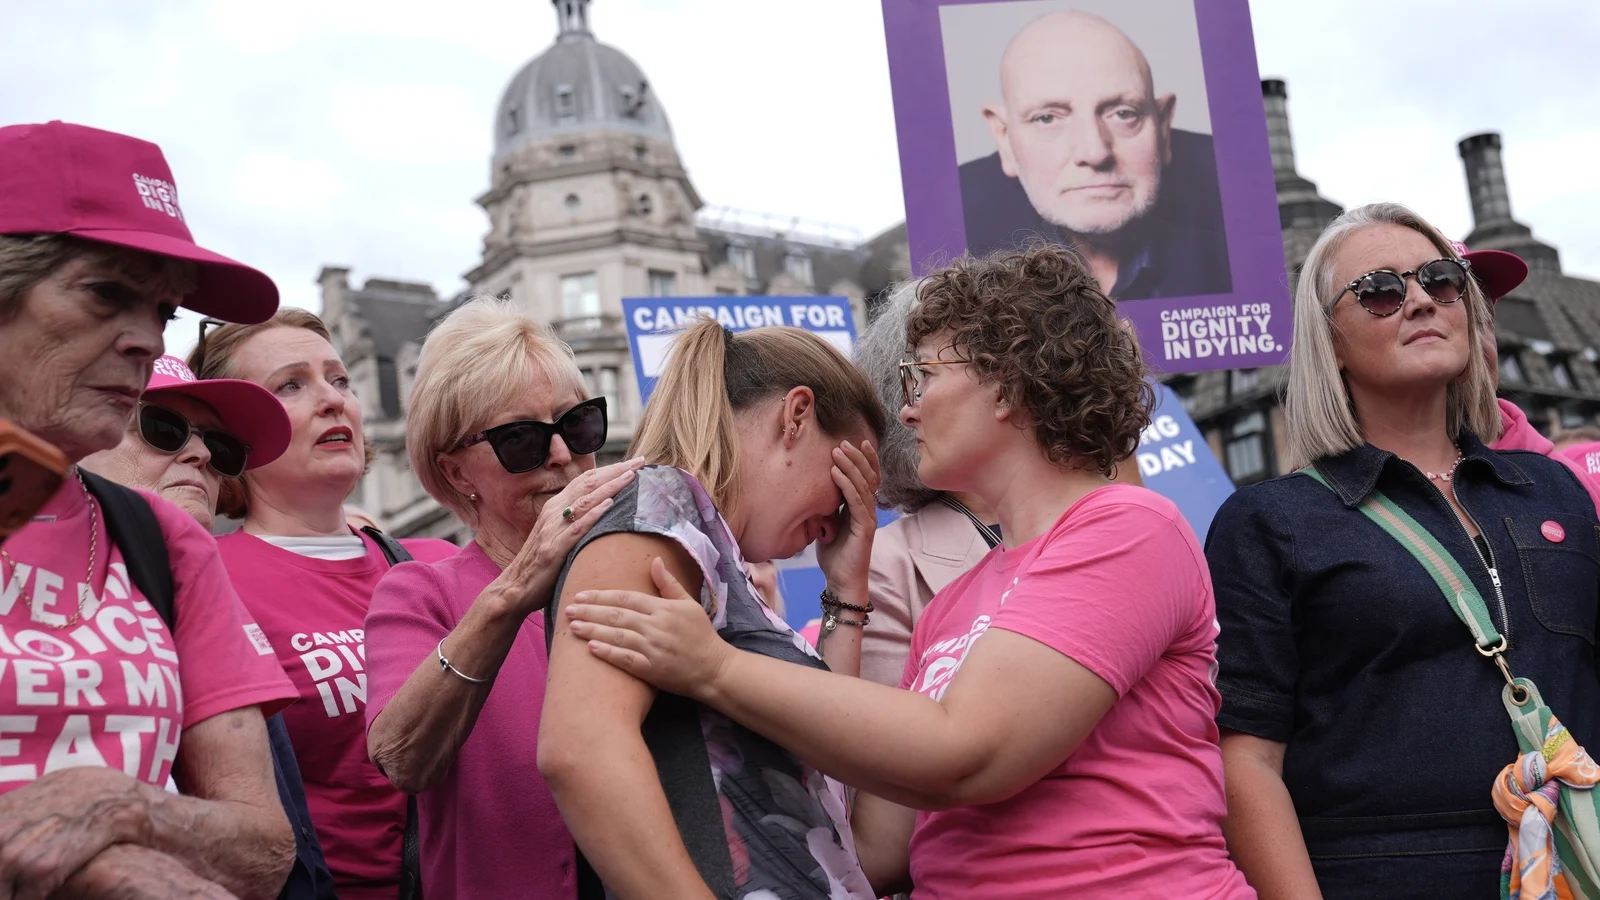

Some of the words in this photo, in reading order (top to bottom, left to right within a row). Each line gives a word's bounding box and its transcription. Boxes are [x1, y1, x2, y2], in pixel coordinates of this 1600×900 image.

[141, 195, 165, 212] IN
[789, 304, 846, 328] FOR
[1160, 305, 1238, 322] CAMPAIGN
[1241, 302, 1272, 316] FOR
[1161, 314, 1272, 341] DIGNITY
[1164, 340, 1192, 361] IN
[1194, 333, 1283, 359] DYING.
[1136, 439, 1197, 477] DAY
[299, 644, 366, 682] DI
[119, 660, 183, 715] MY
[316, 673, 367, 718] IN
